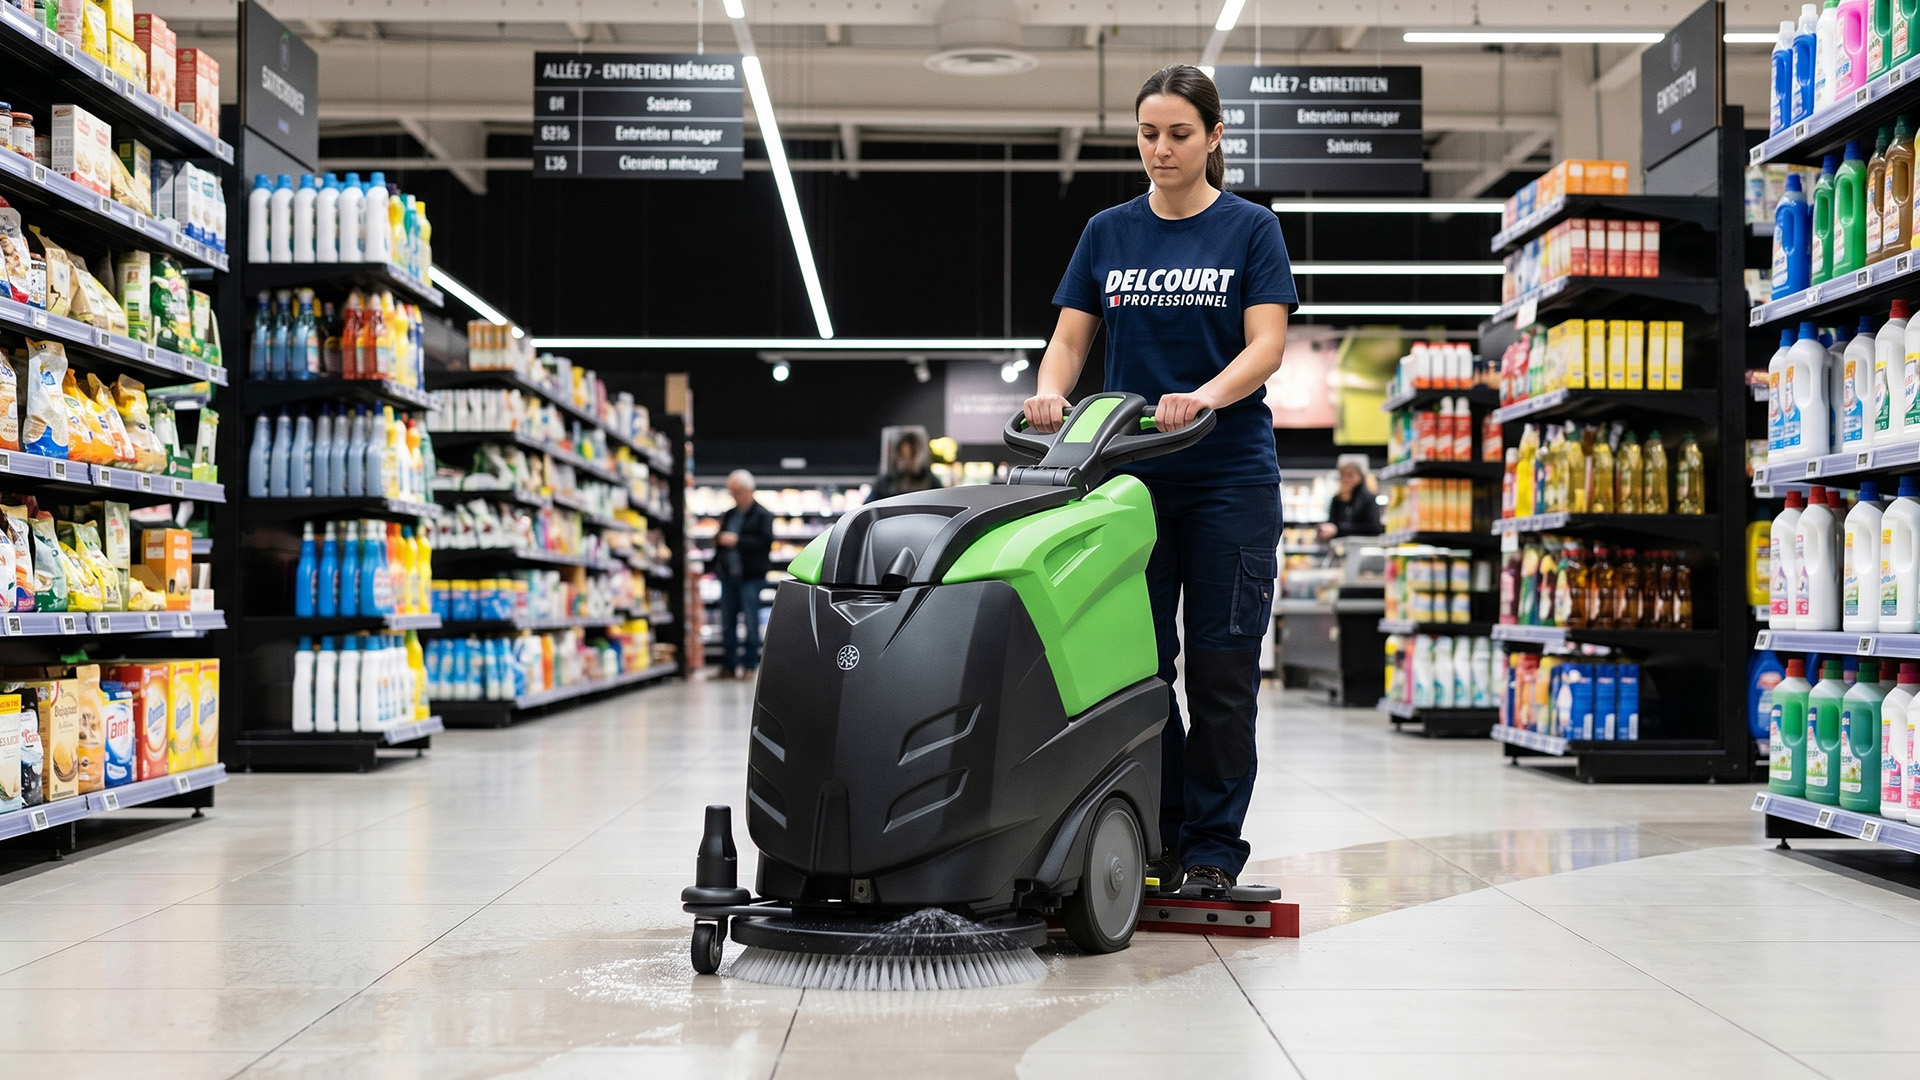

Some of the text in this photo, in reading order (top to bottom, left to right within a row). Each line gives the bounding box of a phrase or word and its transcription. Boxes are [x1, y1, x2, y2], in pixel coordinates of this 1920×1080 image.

[543, 59, 582, 79] ALLÉE
[583, 64, 593, 78] 7
[602, 63, 671, 80] ENTRETIEN
[673, 60, 735, 81] MÉNAGER
[1249, 73, 1289, 93] ALLÉE
[1290, 76, 1299, 92] 7
[1297, 108, 1400, 127] Entretien ménager
[615, 124, 723, 145] Entretien ménager
[668, 154, 719, 175] ménager
[1105, 268, 1235, 294] DELCOURT
[1123, 294, 1227, 308] PROFESSIONNEL
